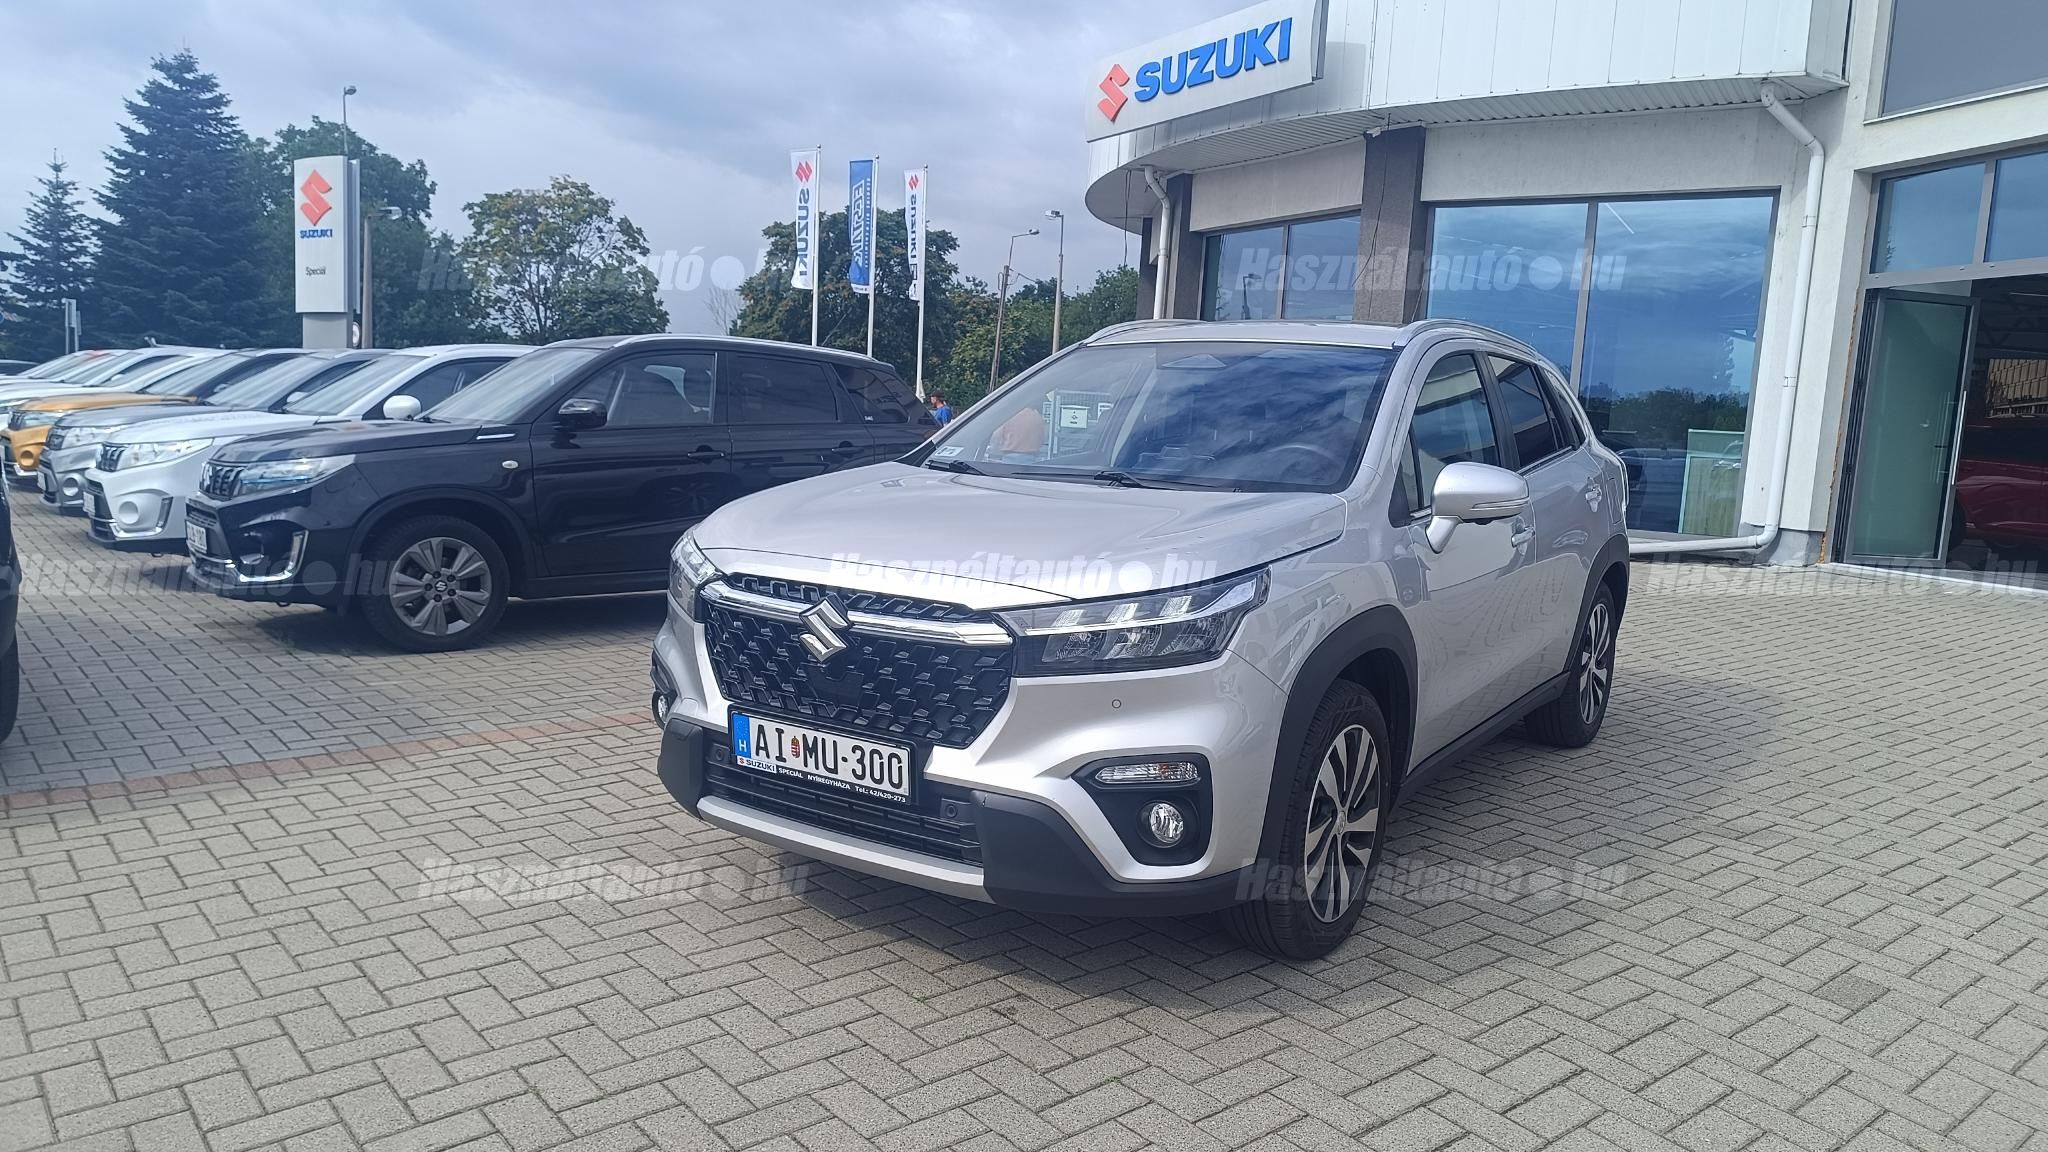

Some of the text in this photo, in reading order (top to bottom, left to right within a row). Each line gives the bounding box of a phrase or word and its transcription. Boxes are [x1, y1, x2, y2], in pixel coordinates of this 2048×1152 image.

[1134, 17, 1293, 101] SUZUKI
[300, 228, 333, 239] SUZUKI
[738, 739, 747, 752] H
[746, 758, 776, 773] SUZUKI
